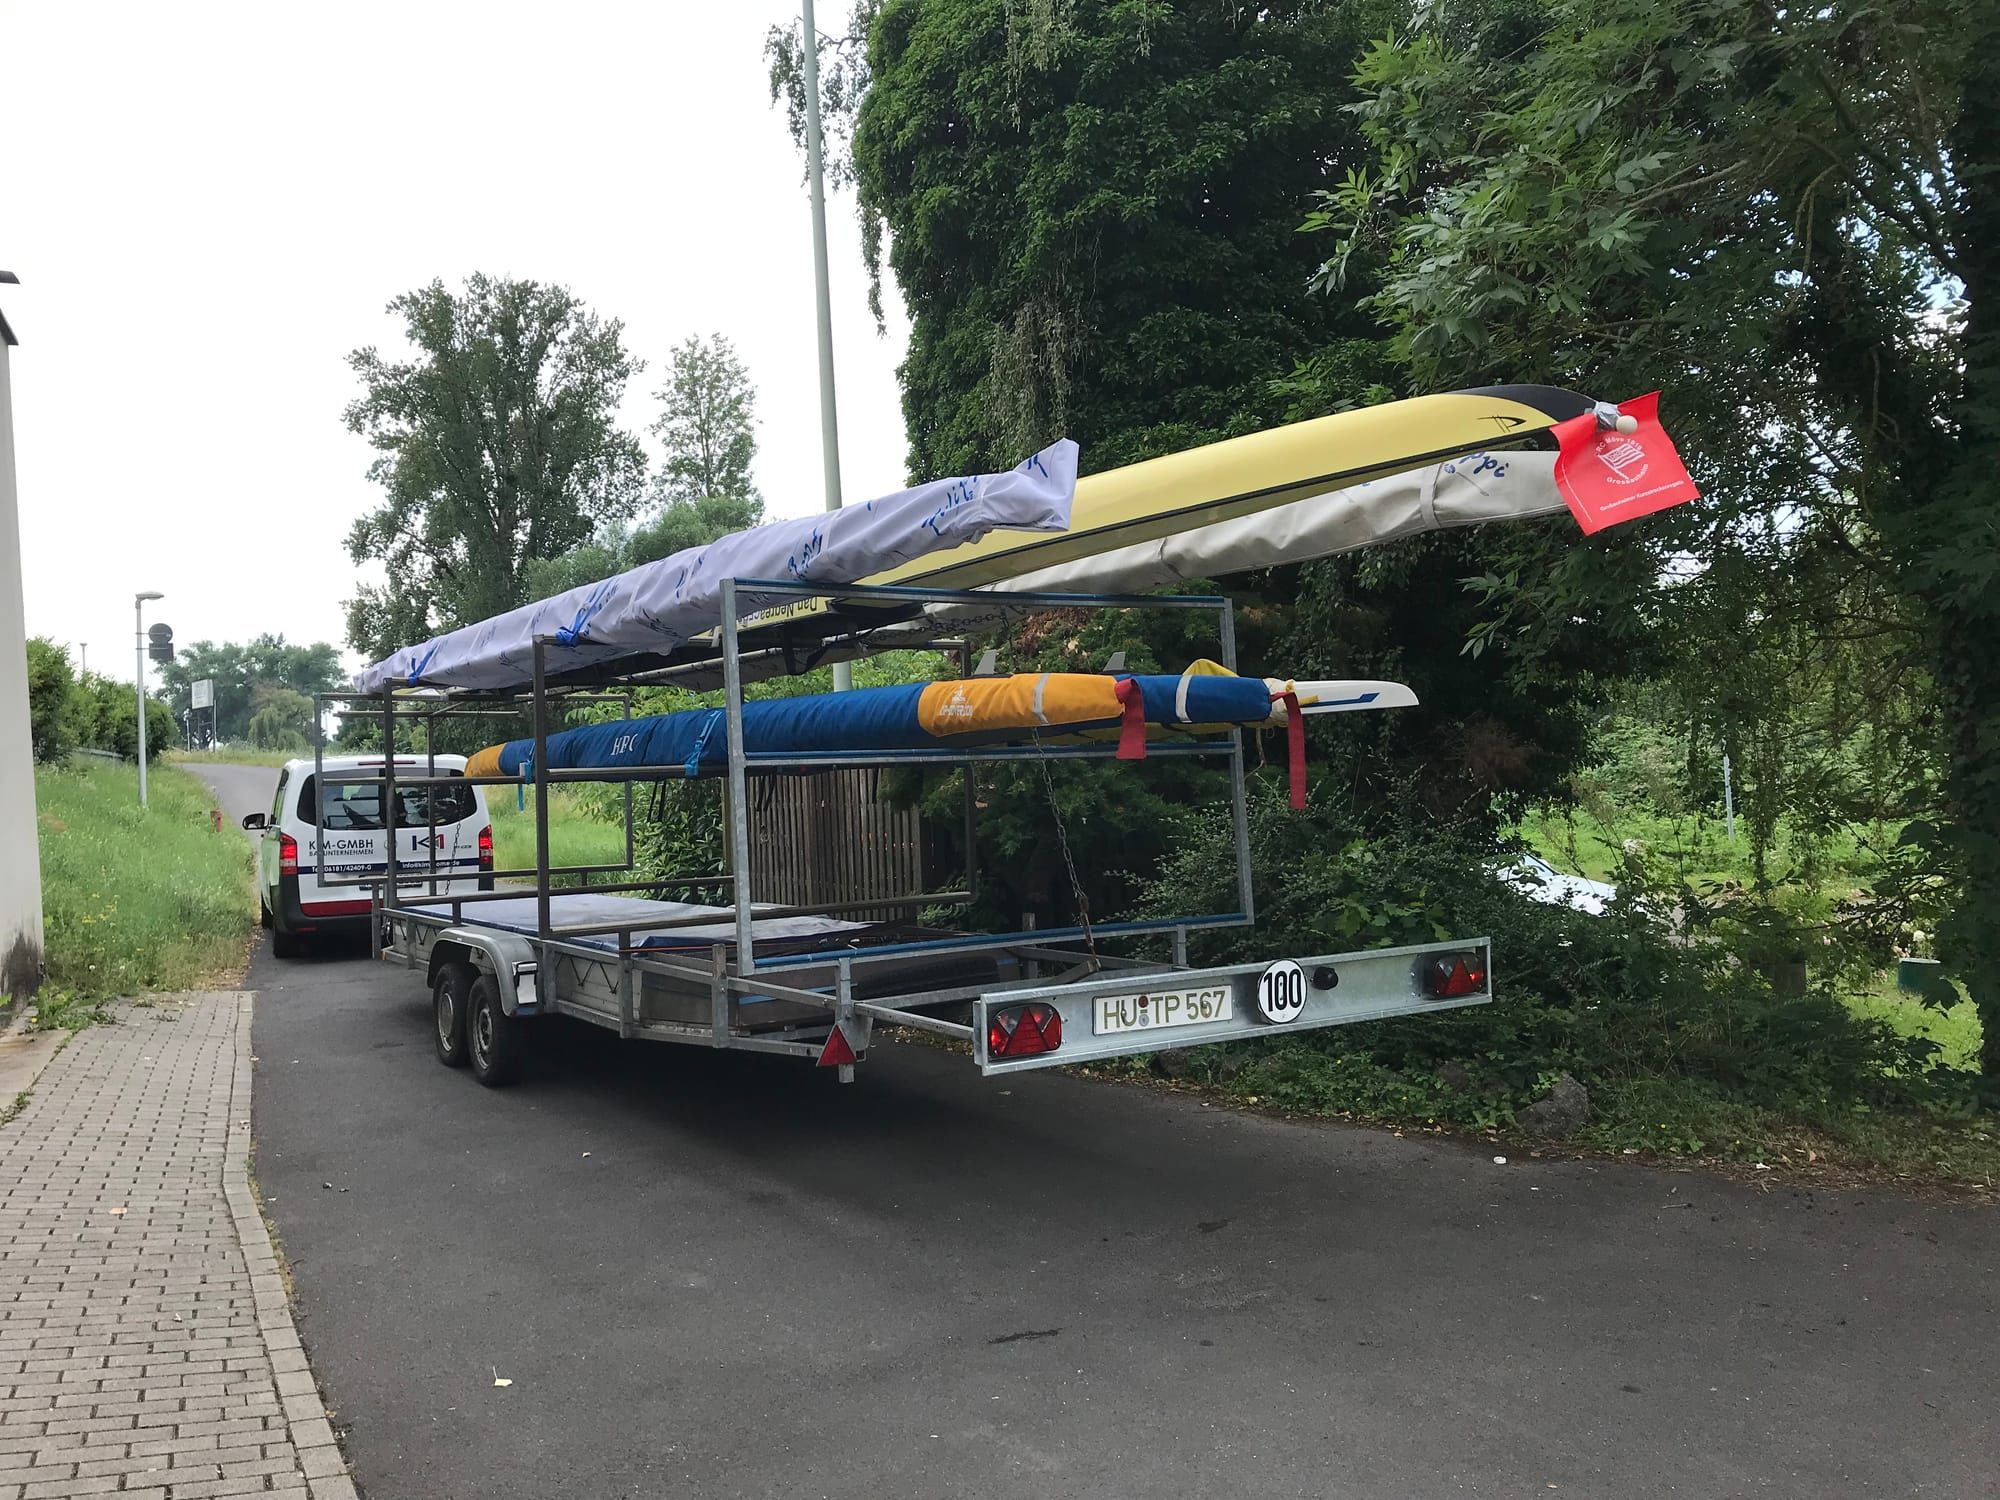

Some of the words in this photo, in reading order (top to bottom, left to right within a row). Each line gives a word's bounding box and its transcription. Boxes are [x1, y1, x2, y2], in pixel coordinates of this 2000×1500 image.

[309, 840, 373, 849] KM-GMBH
[1186, 990, 1226, 1019] 567
[1263, 969, 1302, 1012] 100
